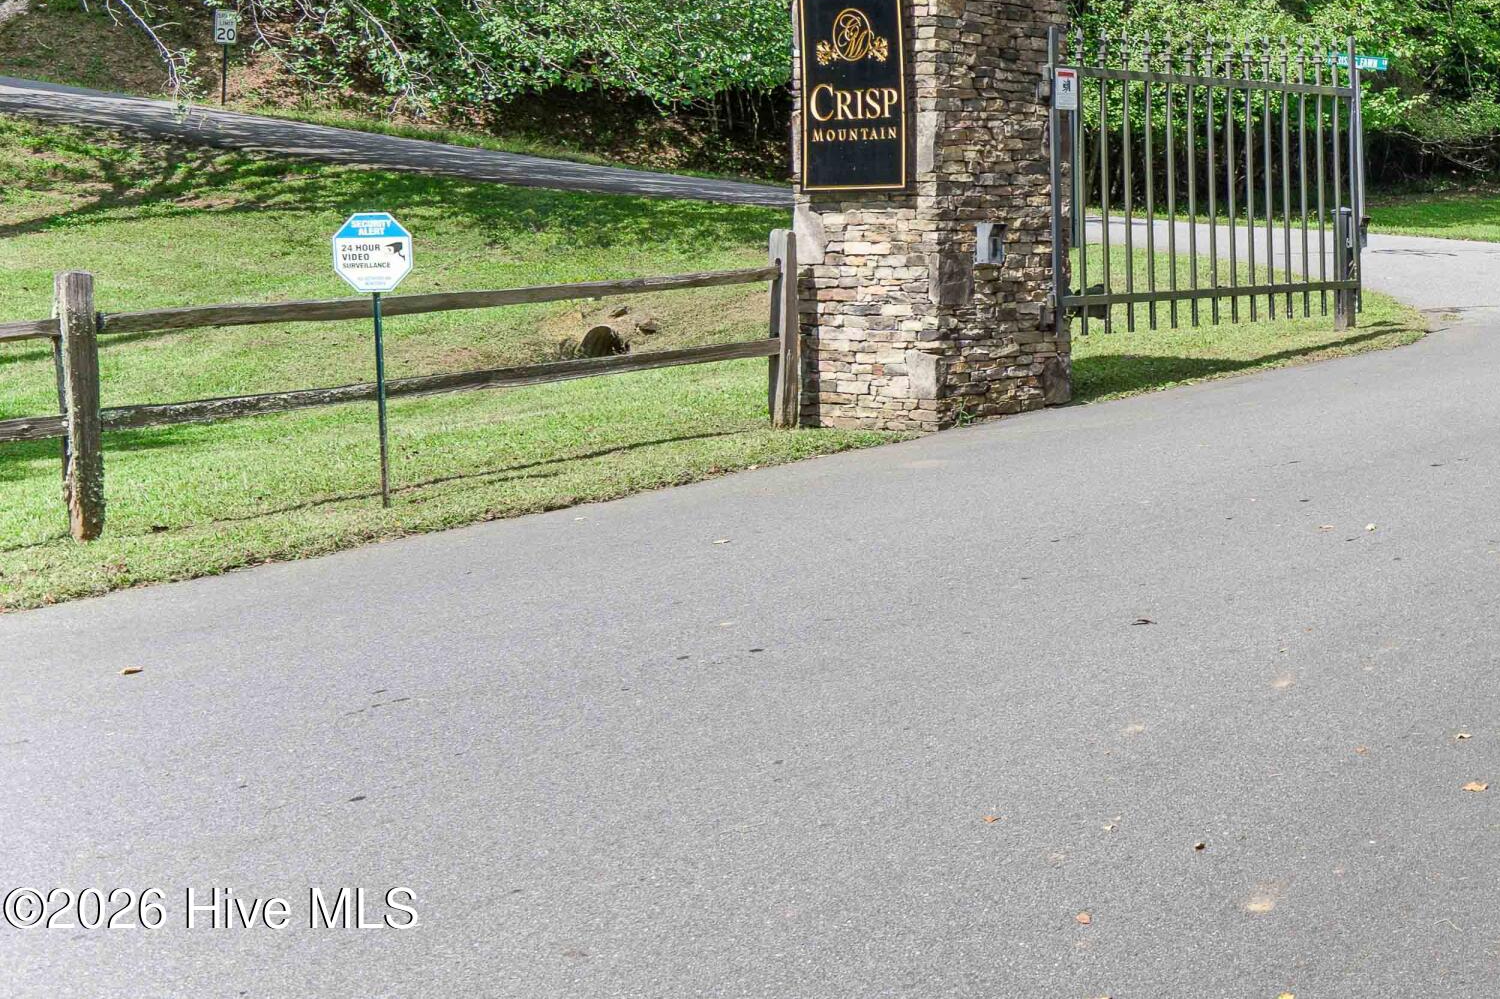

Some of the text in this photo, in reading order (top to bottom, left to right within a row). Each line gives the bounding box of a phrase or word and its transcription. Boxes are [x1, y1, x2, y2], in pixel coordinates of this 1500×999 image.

[217, 27, 236, 41] 20
[810, 84, 898, 122] CRISP
[812, 126, 897, 143] MOUNTAIN
[341, 243, 381, 252] 24 HOUR
[342, 253, 370, 261] VIDEO
